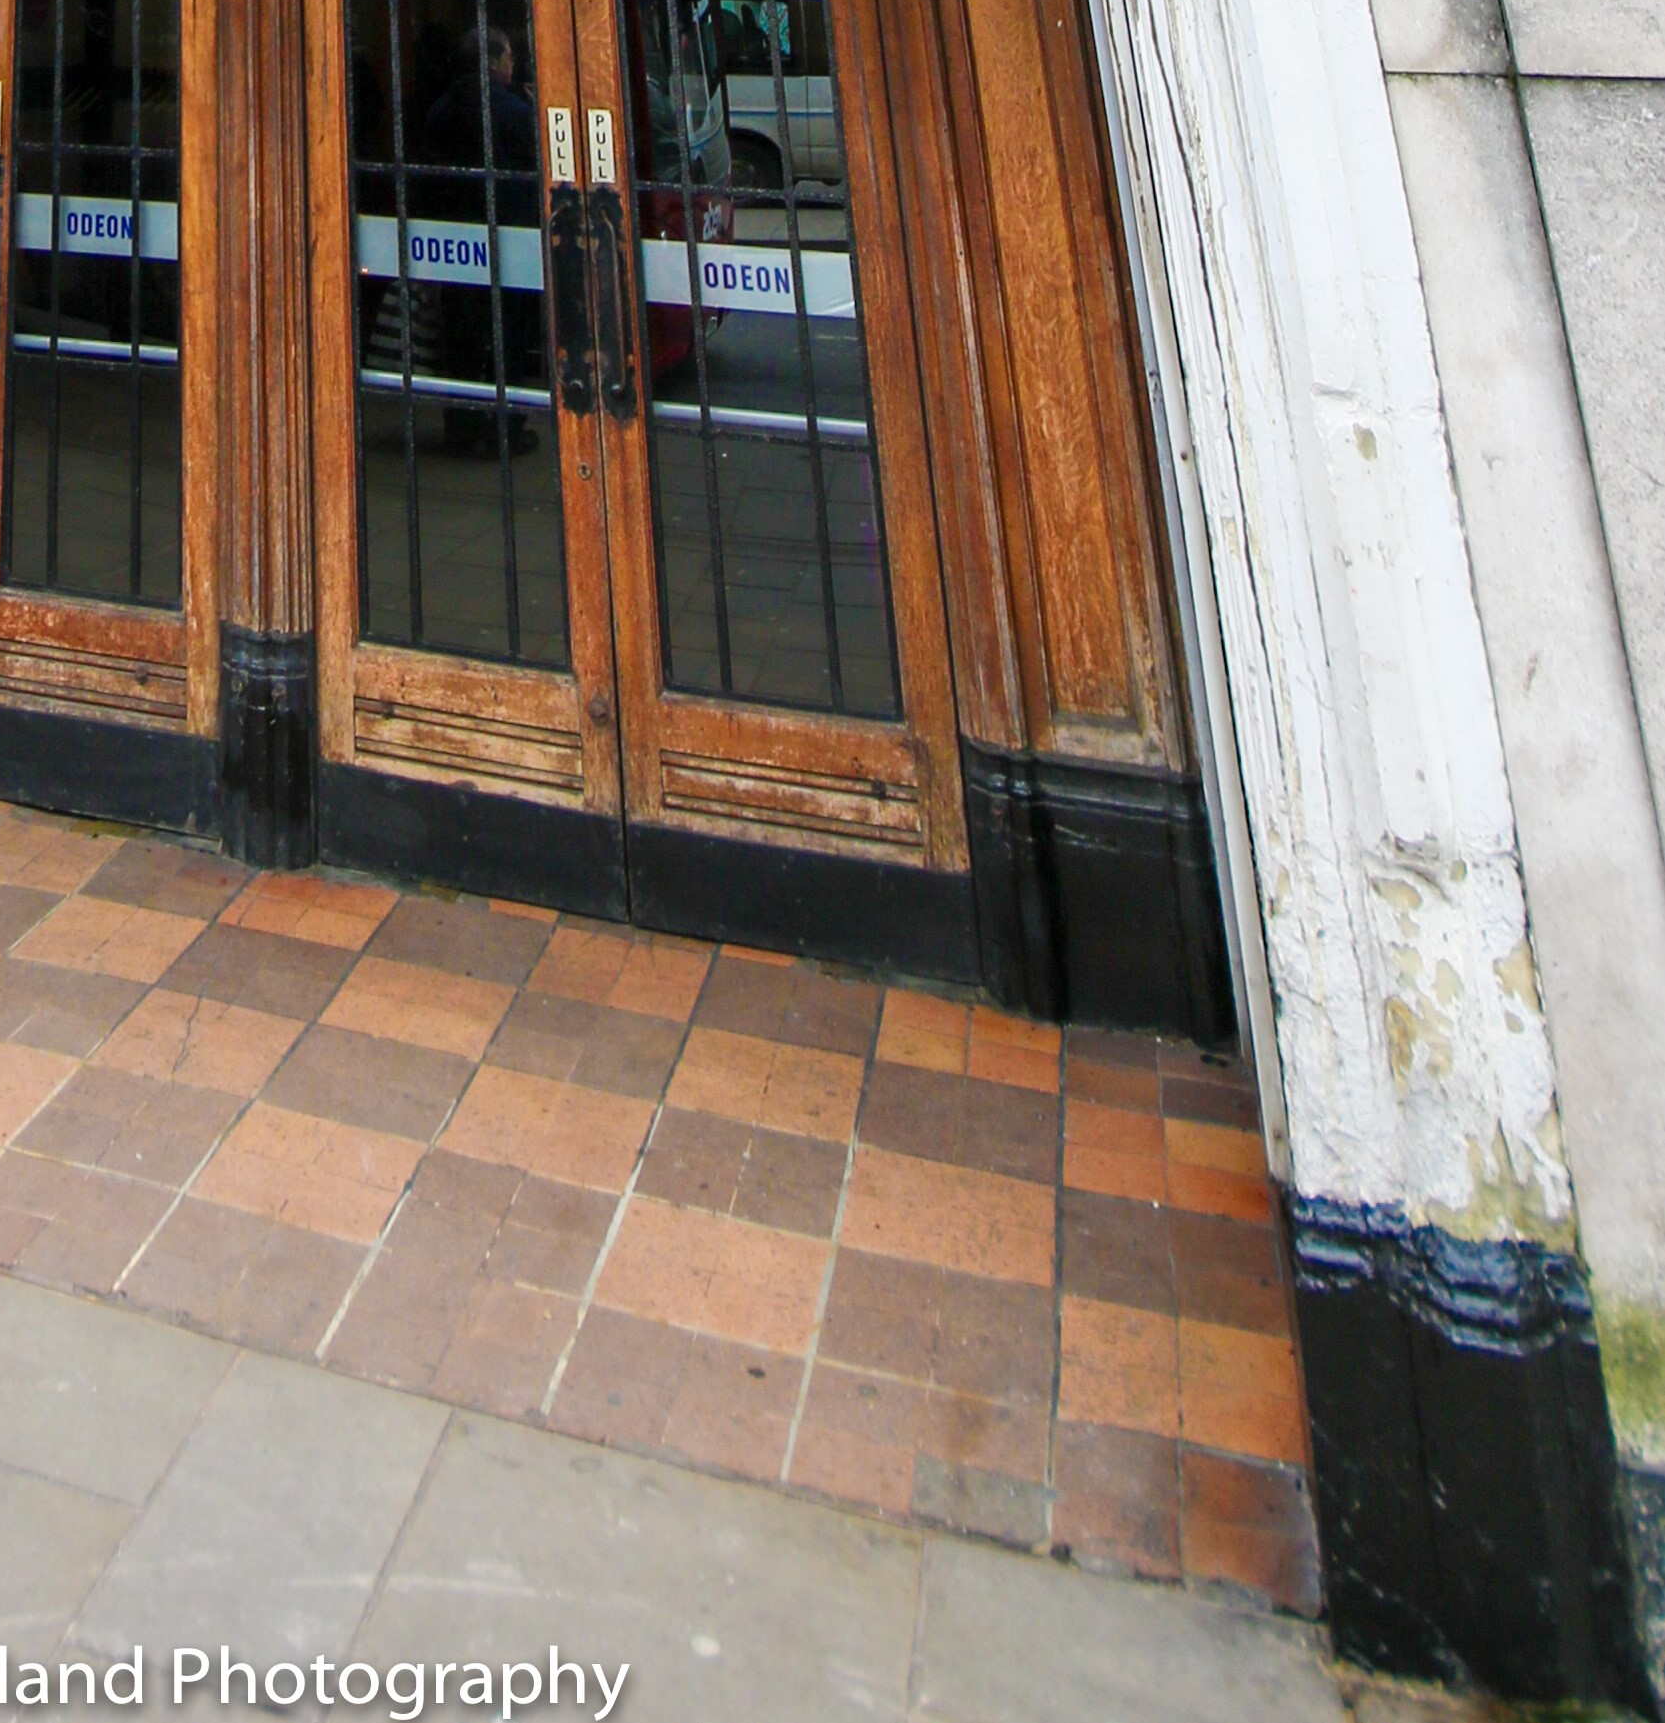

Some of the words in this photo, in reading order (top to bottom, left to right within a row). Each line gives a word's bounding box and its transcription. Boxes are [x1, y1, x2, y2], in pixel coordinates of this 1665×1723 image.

[554, 112, 568, 177] PULL
[595, 114, 608, 179] PULL
[66, 212, 133, 239] ODEON
[411, 236, 487, 267] ODEON
[703, 261, 791, 295] ODEON
